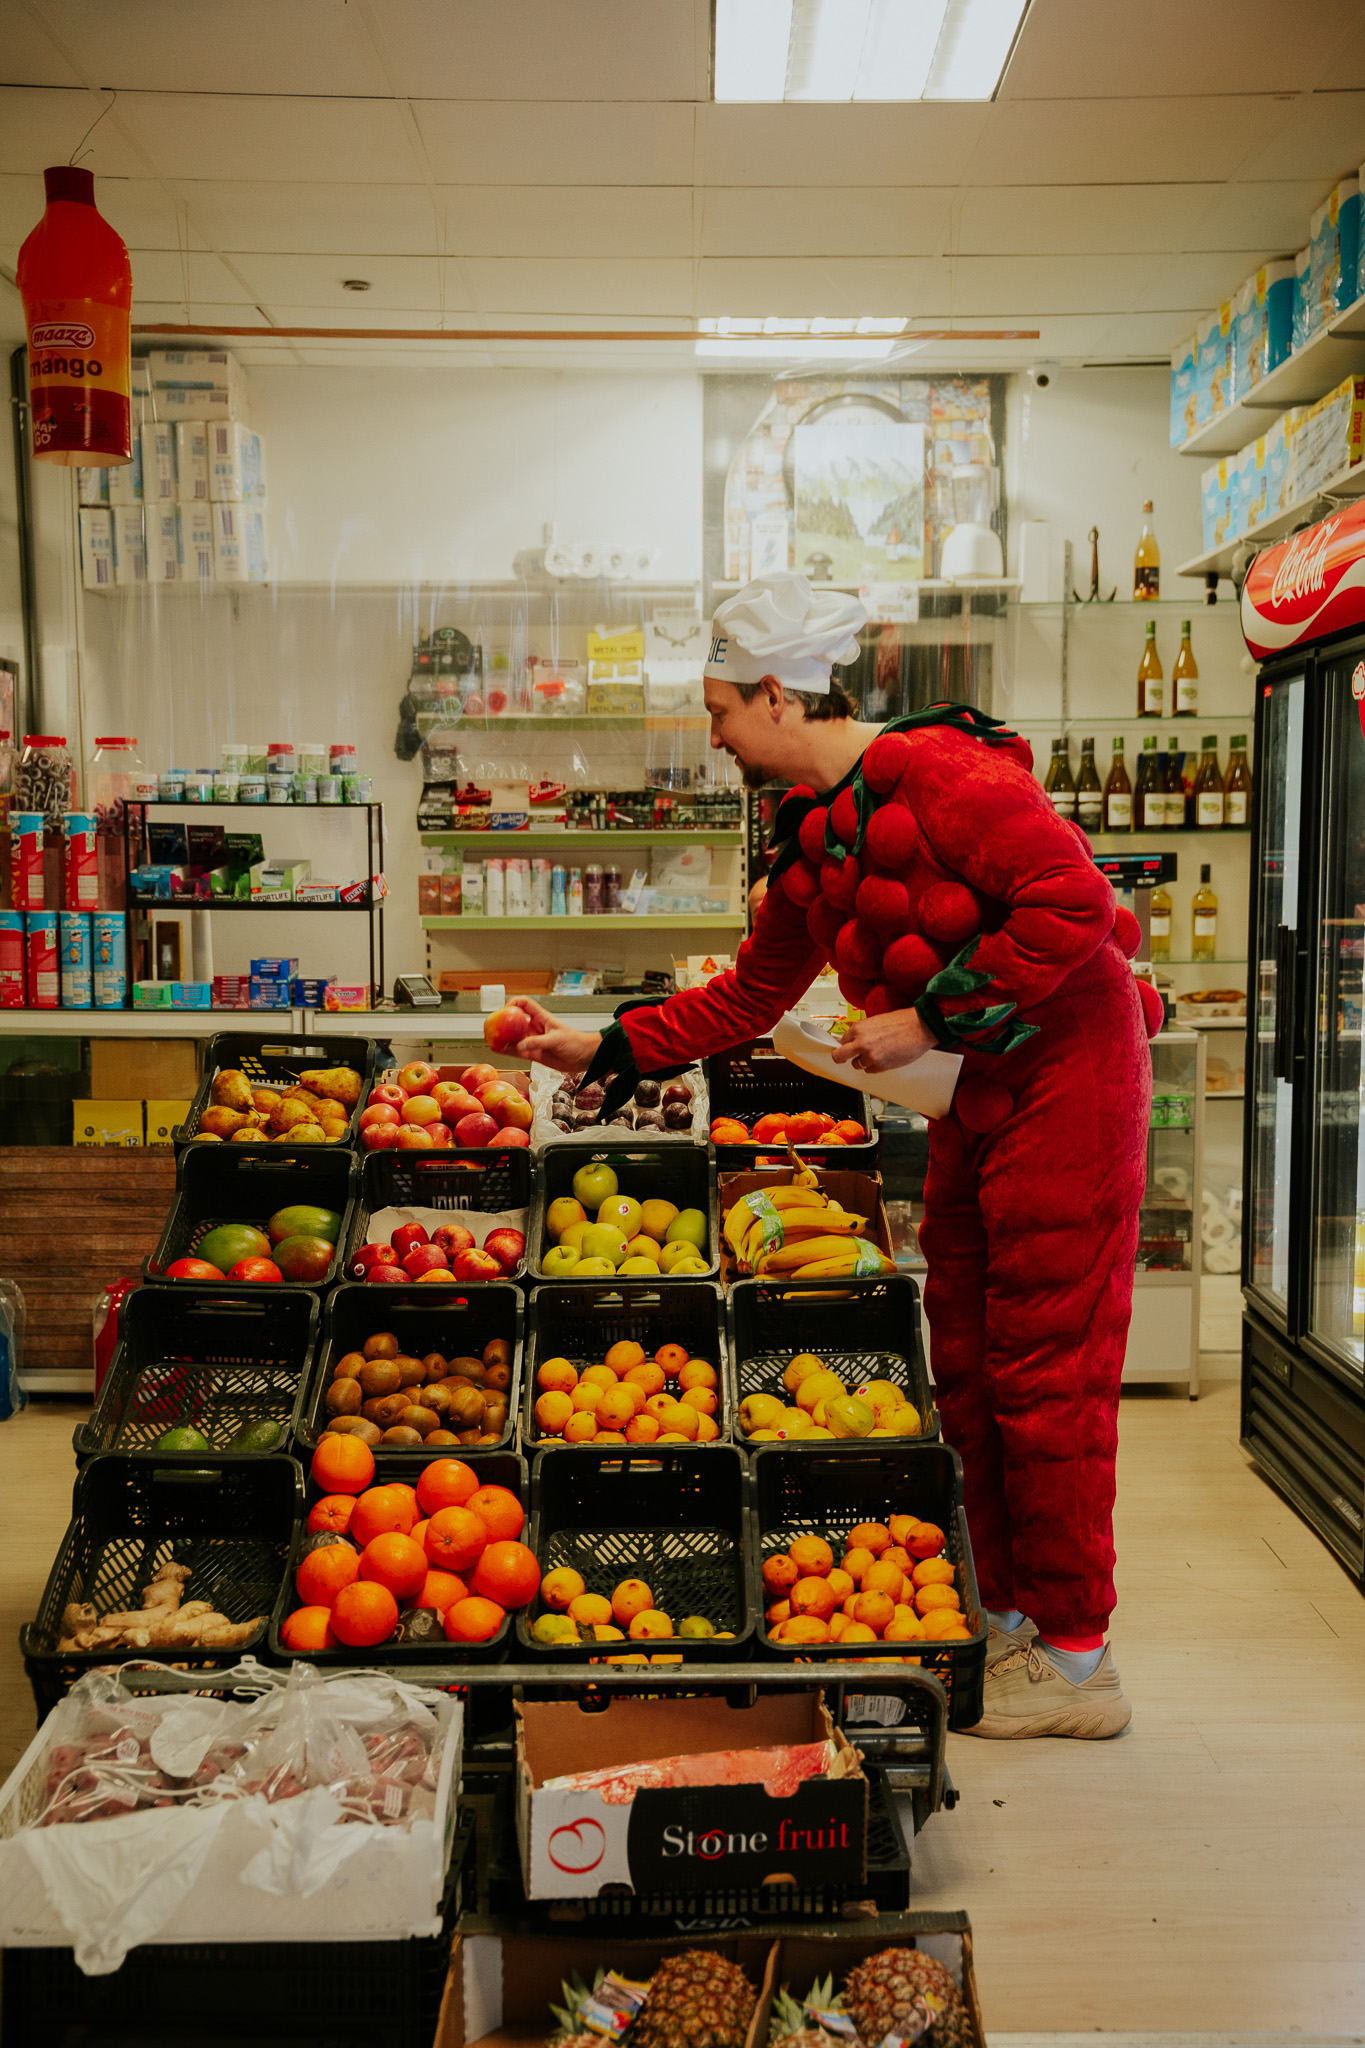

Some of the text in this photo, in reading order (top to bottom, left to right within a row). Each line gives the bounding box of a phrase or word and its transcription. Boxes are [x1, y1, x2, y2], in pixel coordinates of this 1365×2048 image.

[31, 358, 102, 378] mango
[253, 892, 289, 902] SPORTLIFE
[298, 893, 333, 902] SPORTLIFE
[346, 881, 370, 900] mento
[127, 1137, 139, 1147] 12
[661, 1817, 851, 1861] Stone fruit
